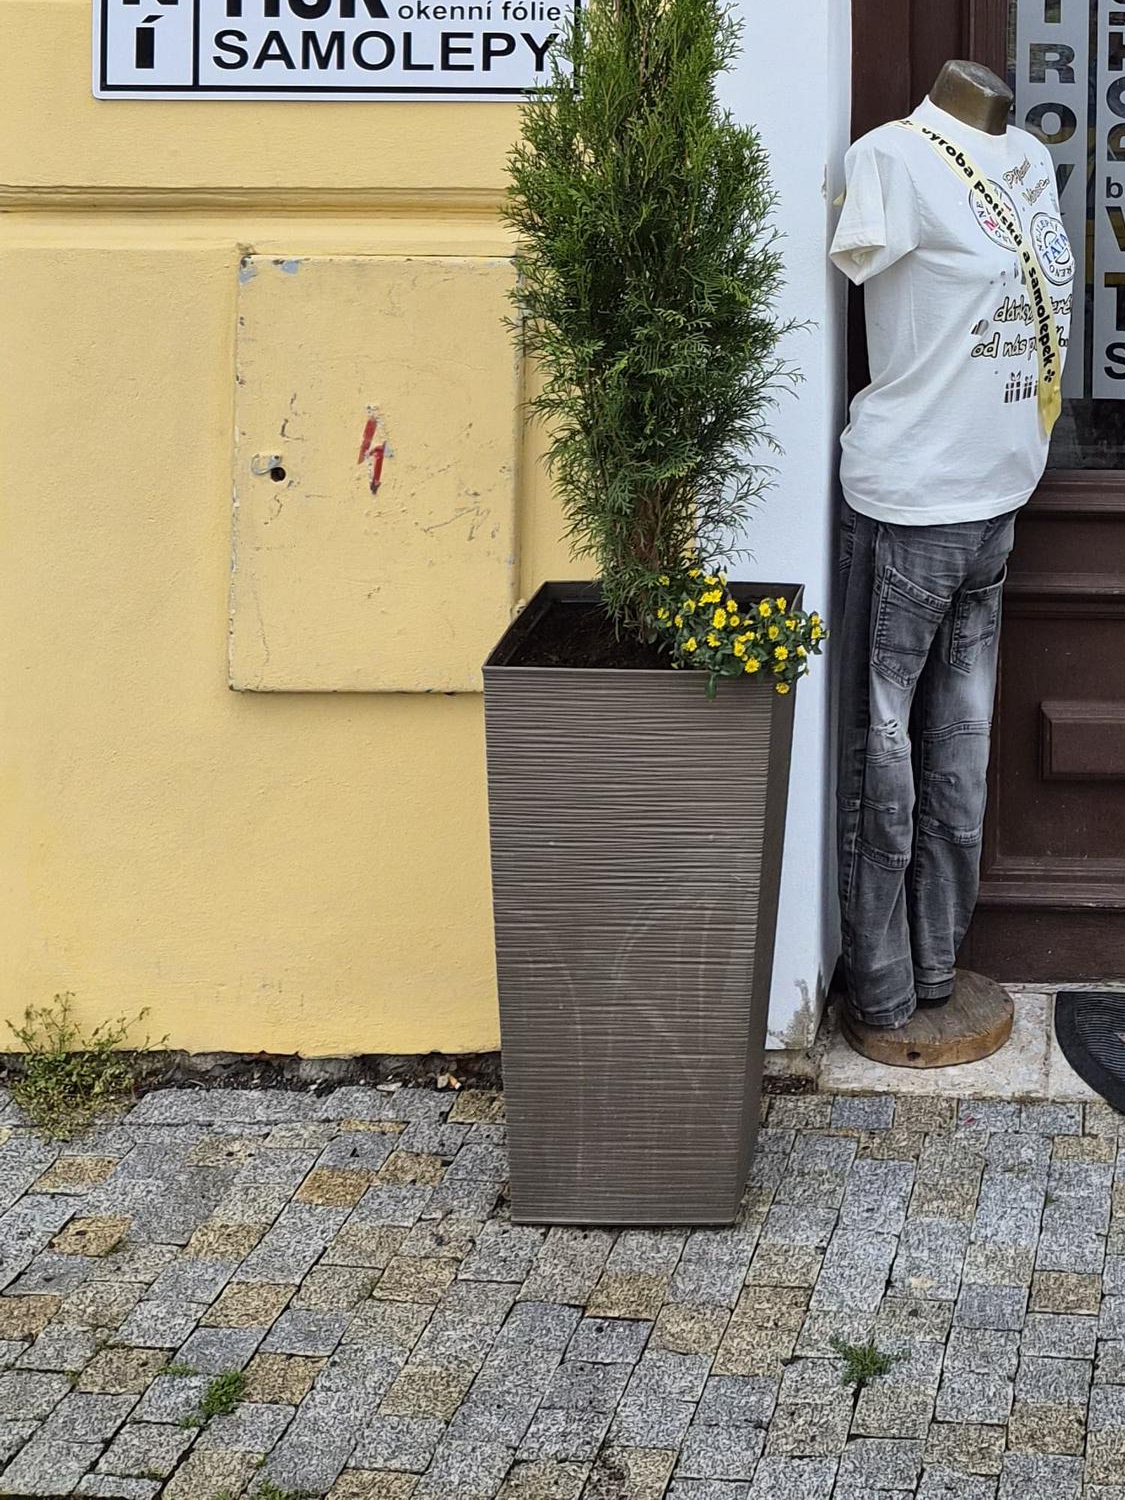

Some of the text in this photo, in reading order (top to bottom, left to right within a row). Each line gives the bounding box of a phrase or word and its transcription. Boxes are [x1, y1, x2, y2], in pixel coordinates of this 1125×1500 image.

[397, 0, 562, 22] okenní fólie
[212, 28, 560, 72] SAMOLEPY
[921, 127, 974, 178] výroba
[973, 180, 1023, 247] potisků
[1022, 251, 1031, 263] a
[1028, 266, 1056, 368] samolepek
[971, 332, 1000, 358] od
